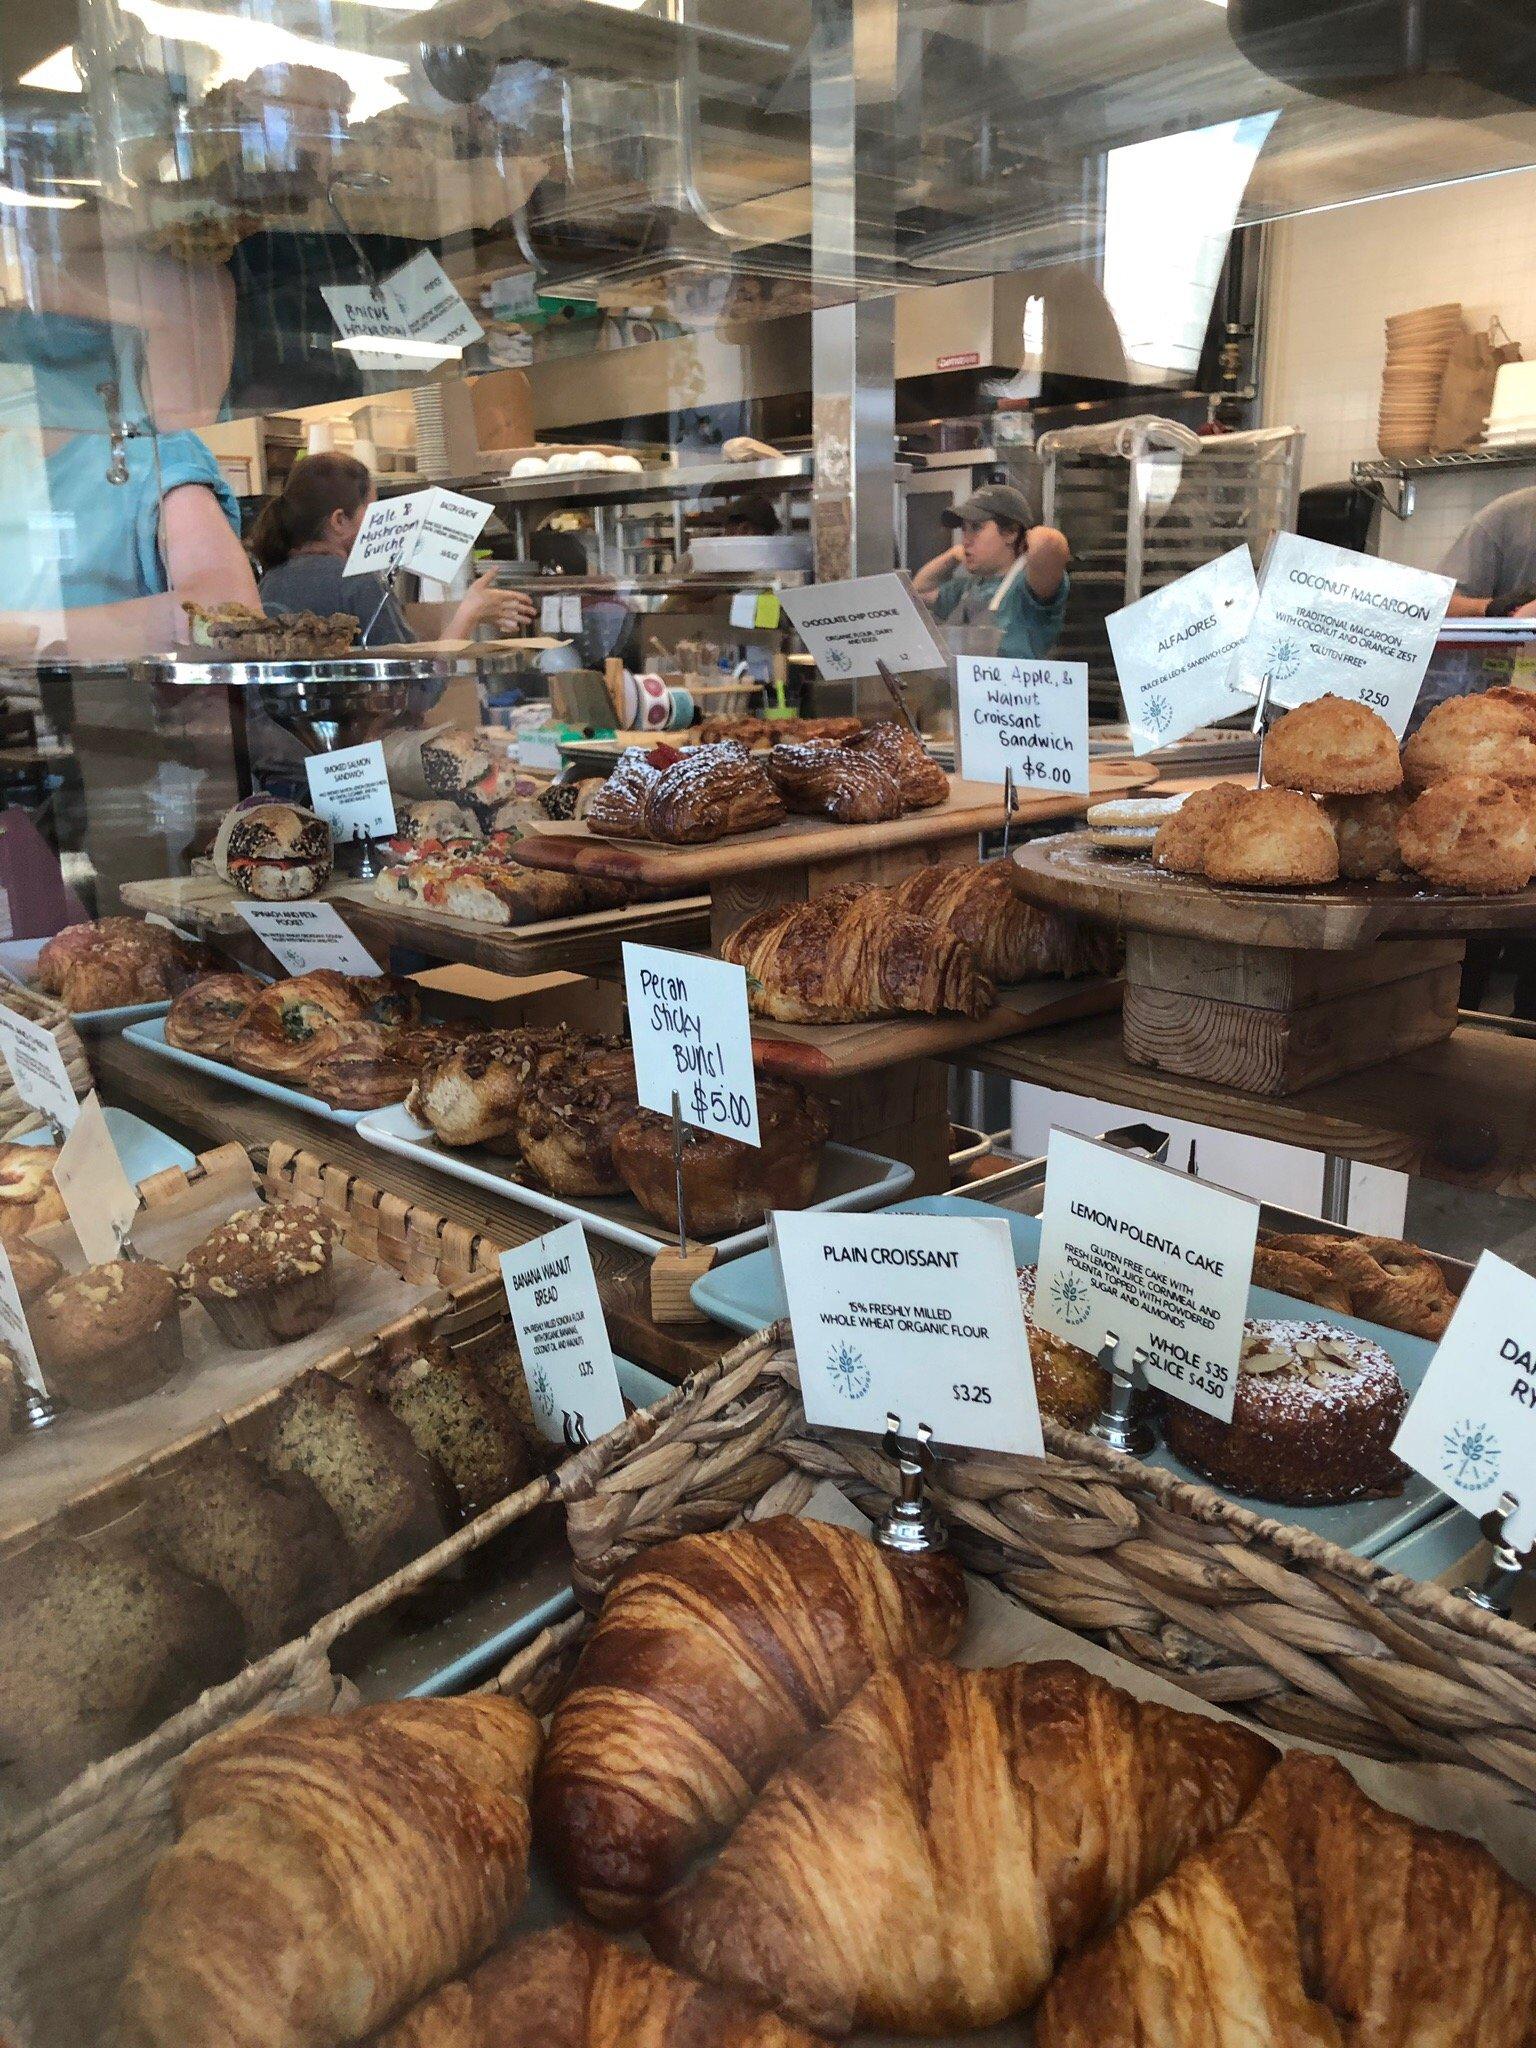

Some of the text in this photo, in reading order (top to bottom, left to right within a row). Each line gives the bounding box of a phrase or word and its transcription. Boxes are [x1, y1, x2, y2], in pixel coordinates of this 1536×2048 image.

[360, 519, 420, 543] Mushroom
[369, 508, 397, 528] Kale
[1289, 569, 1431, 622] COCONUT MACAROON
[802, 608, 900, 628] CHOCOLATE CHIP COOKIE
[1157, 614, 1218, 653] ALFAJORES
[1296, 607, 1403, 646] TRADITIONAL MACAROON
[1276, 612, 1418, 664] WITH COCONUT AND ORANGE ZEST
[1140, 677, 1160, 693] DULCE
[1160, 673, 1170, 684] DE
[1168, 665, 1187, 680] LECHE
[1187, 650, 1222, 671] SANDWICH
[987, 690, 1040, 707] Walnut
[1359, 688, 1390, 708] $2.50
[974, 709, 1041, 729] Croissant
[999, 730, 1073, 751] Sandwich
[1023, 755, 1071, 783] $8.00
[640, 969, 687, 1001] Pecan
[691, 1079, 751, 1127] $5.00
[823, 1245, 959, 1268] PLAIN CROISSANT
[1071, 1200, 1224, 1278] LEMON POLENTA CAKE
[512, 1255, 572, 1291] BANANA WALNUT
[1064, 1242, 1221, 1321] FRESH LEMON JUICE, CORNMEAL AND
[1090, 1243, 1194, 1297] GLUTEN FREE CAKE WITH
[534, 1285, 559, 1307] BREAD
[1067, 1255, 1216, 1331] POLENTA TOPPED WITH POWDERED
[1090, 1277, 1186, 1329] SUGAR AND ALMONDS
[820, 1313, 990, 1339] WHOLE WHEAT ORGANIC FLOUR
[869, 1303, 911, 1318] FRESHLY
[914, 1307, 952, 1321] MILLED
[1149, 1333, 1229, 1382] WHOLE $35
[1500, 1337, 1536, 1375] DA
[952, 1384, 992, 1404] $3.25
[1149, 1352, 1224, 1400] SLICE $4.50
